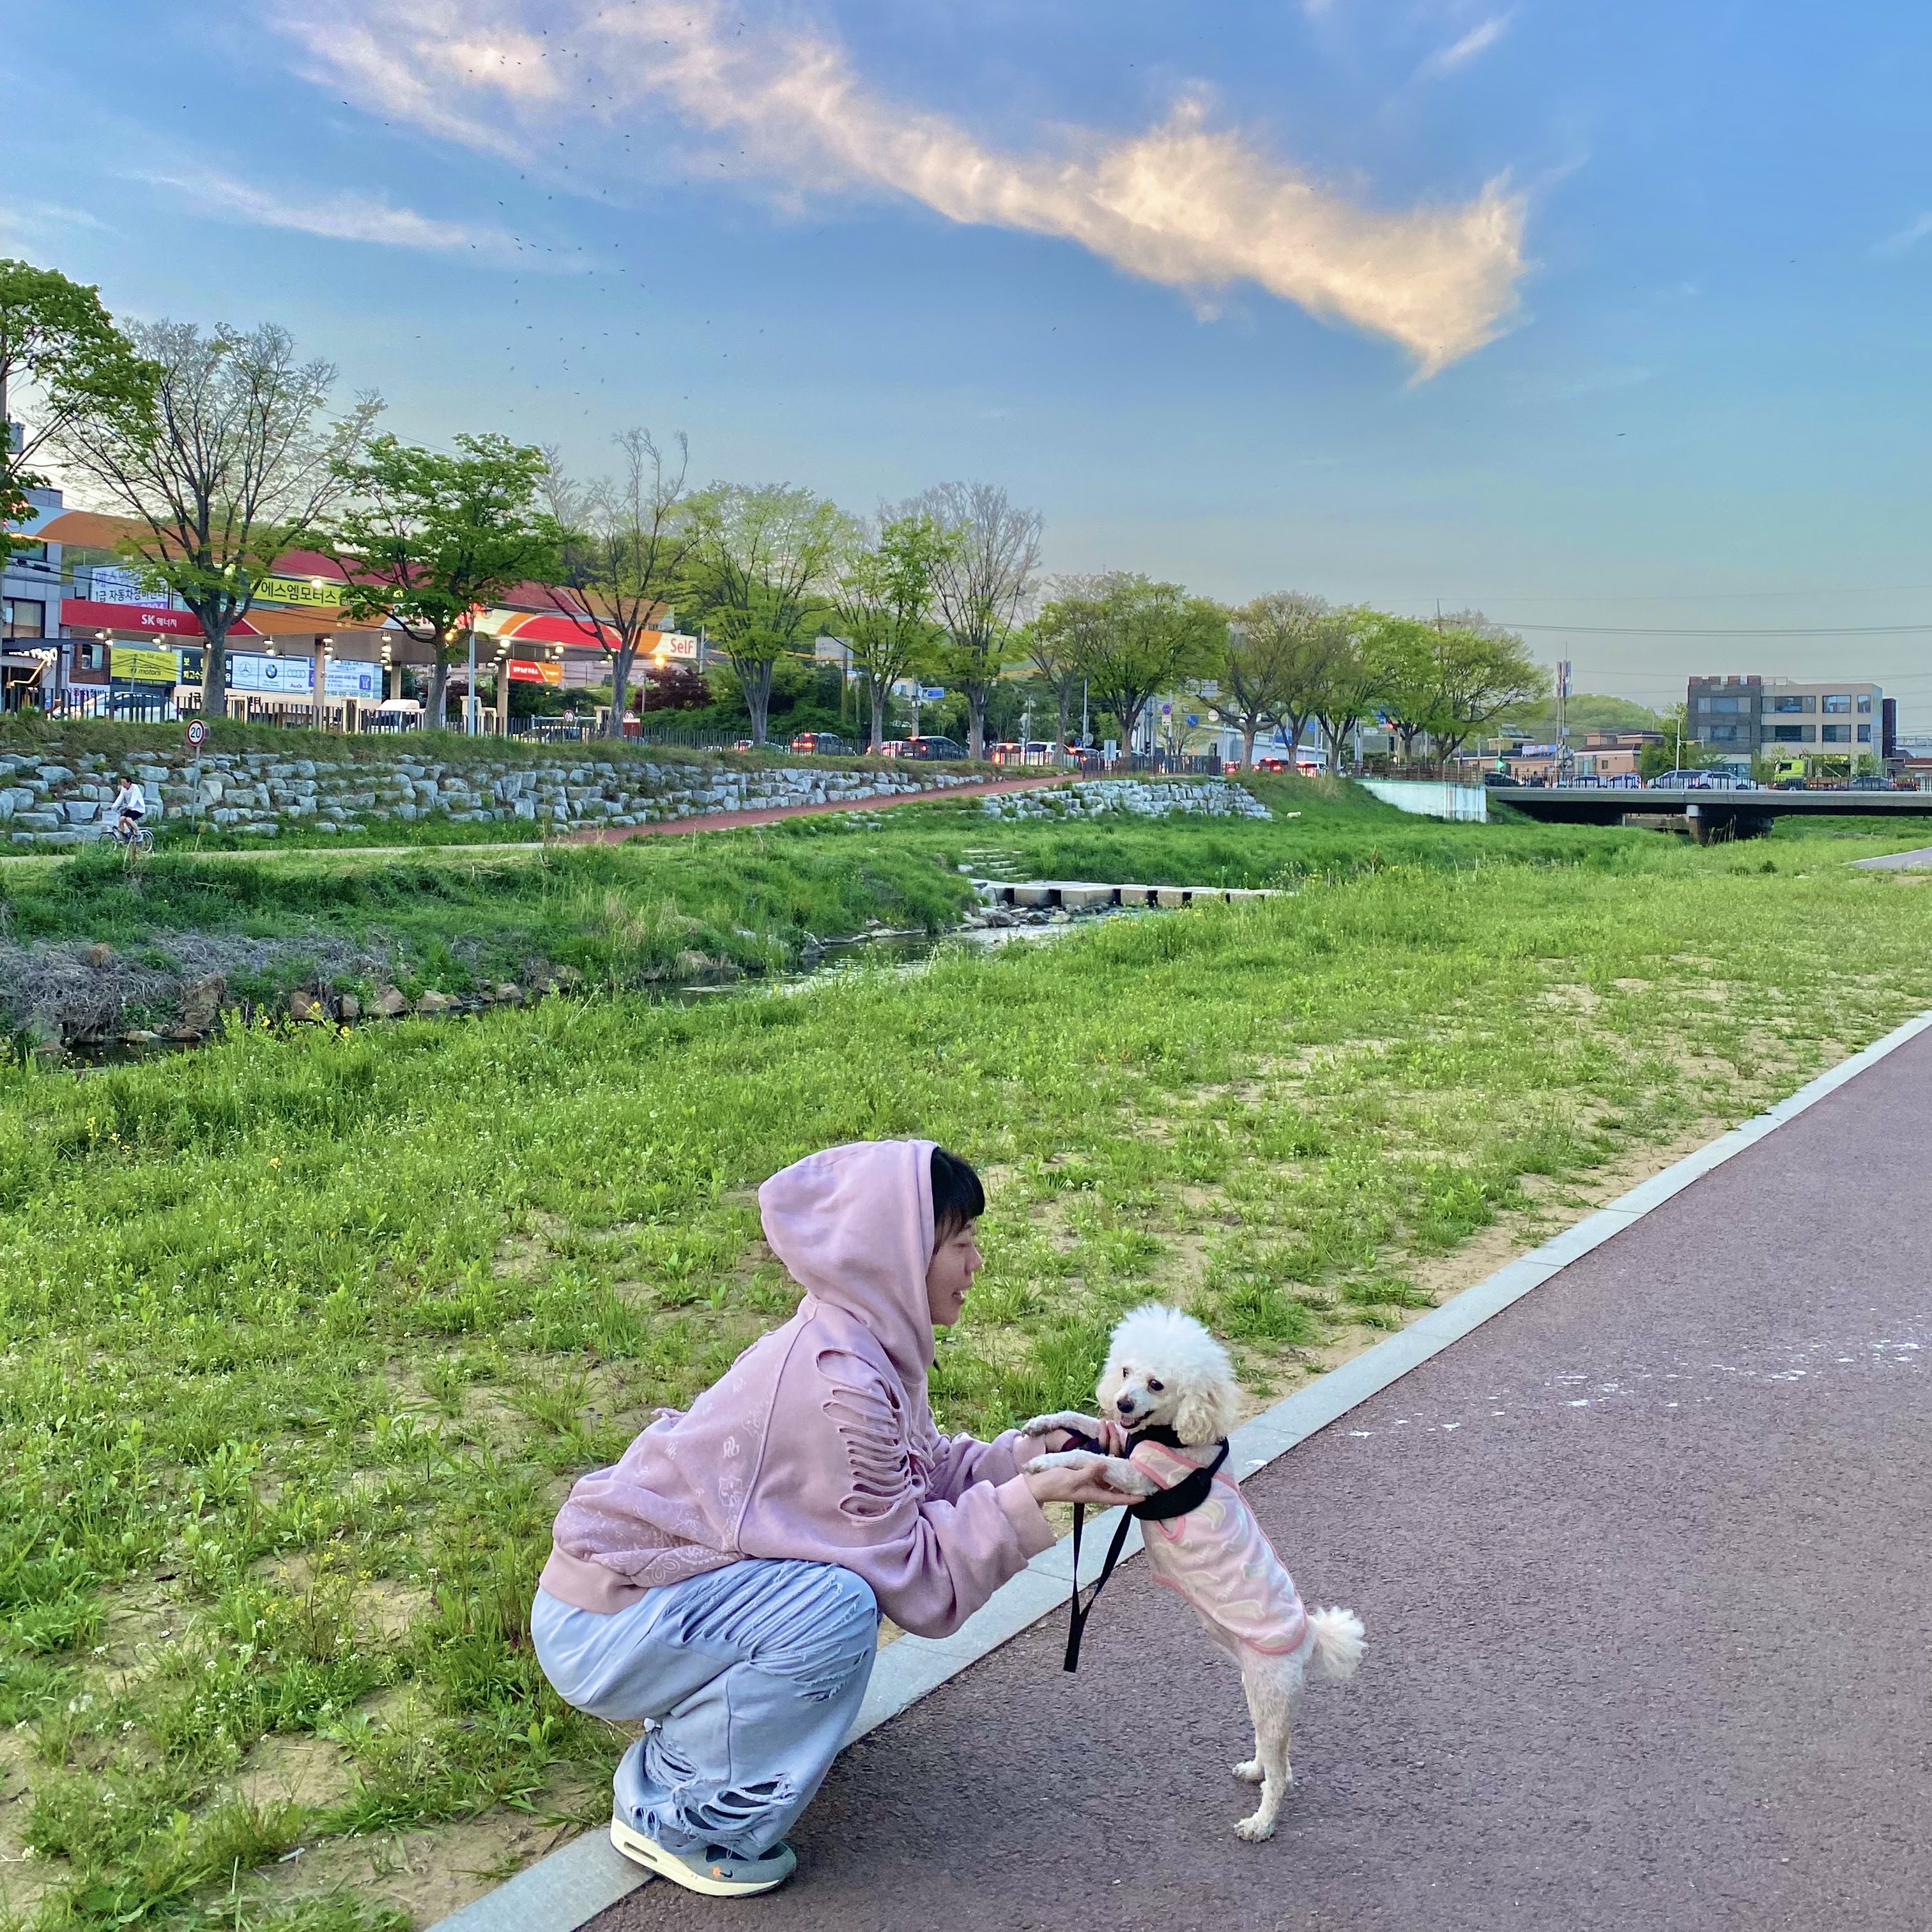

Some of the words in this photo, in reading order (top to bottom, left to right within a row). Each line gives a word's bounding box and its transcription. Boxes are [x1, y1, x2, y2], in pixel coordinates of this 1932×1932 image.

[261, 581, 337, 604] 에스엠모터스
[141, 614, 155, 625] SK
[157, 617, 177, 627] 에너지
[670, 638, 694, 654] Self
[190, 727, 201, 738] 20
